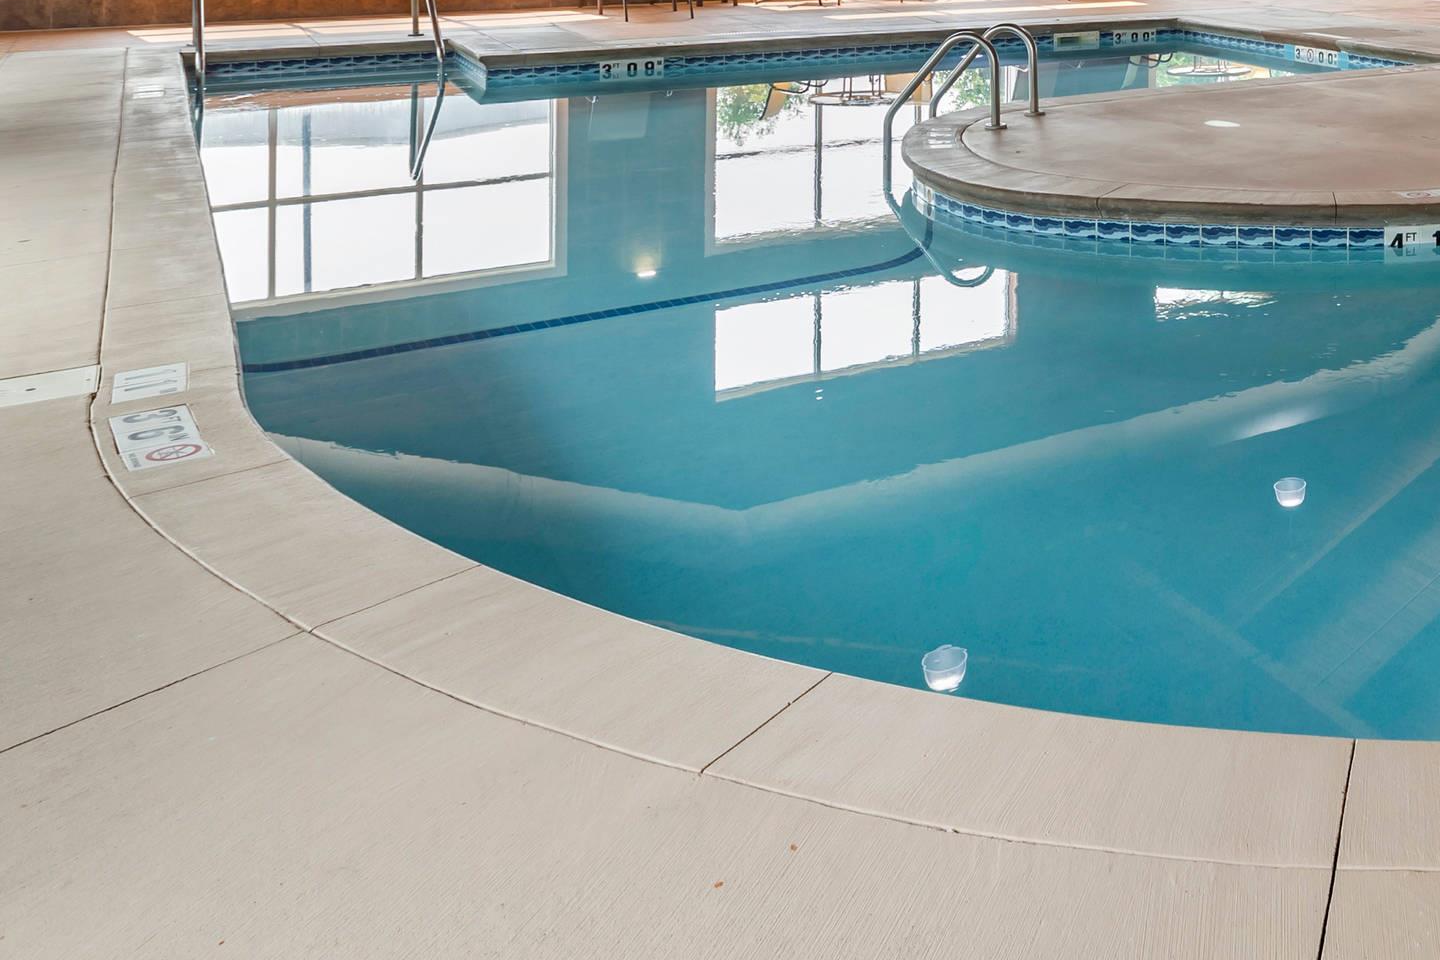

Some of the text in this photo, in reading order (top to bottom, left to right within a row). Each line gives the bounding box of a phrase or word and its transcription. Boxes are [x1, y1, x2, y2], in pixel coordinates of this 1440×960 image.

[1389, 232, 1404, 249] 4
[1406, 232, 1417, 242] FT
[122, 408, 178, 424] 3
[128, 425, 185, 441] 6
